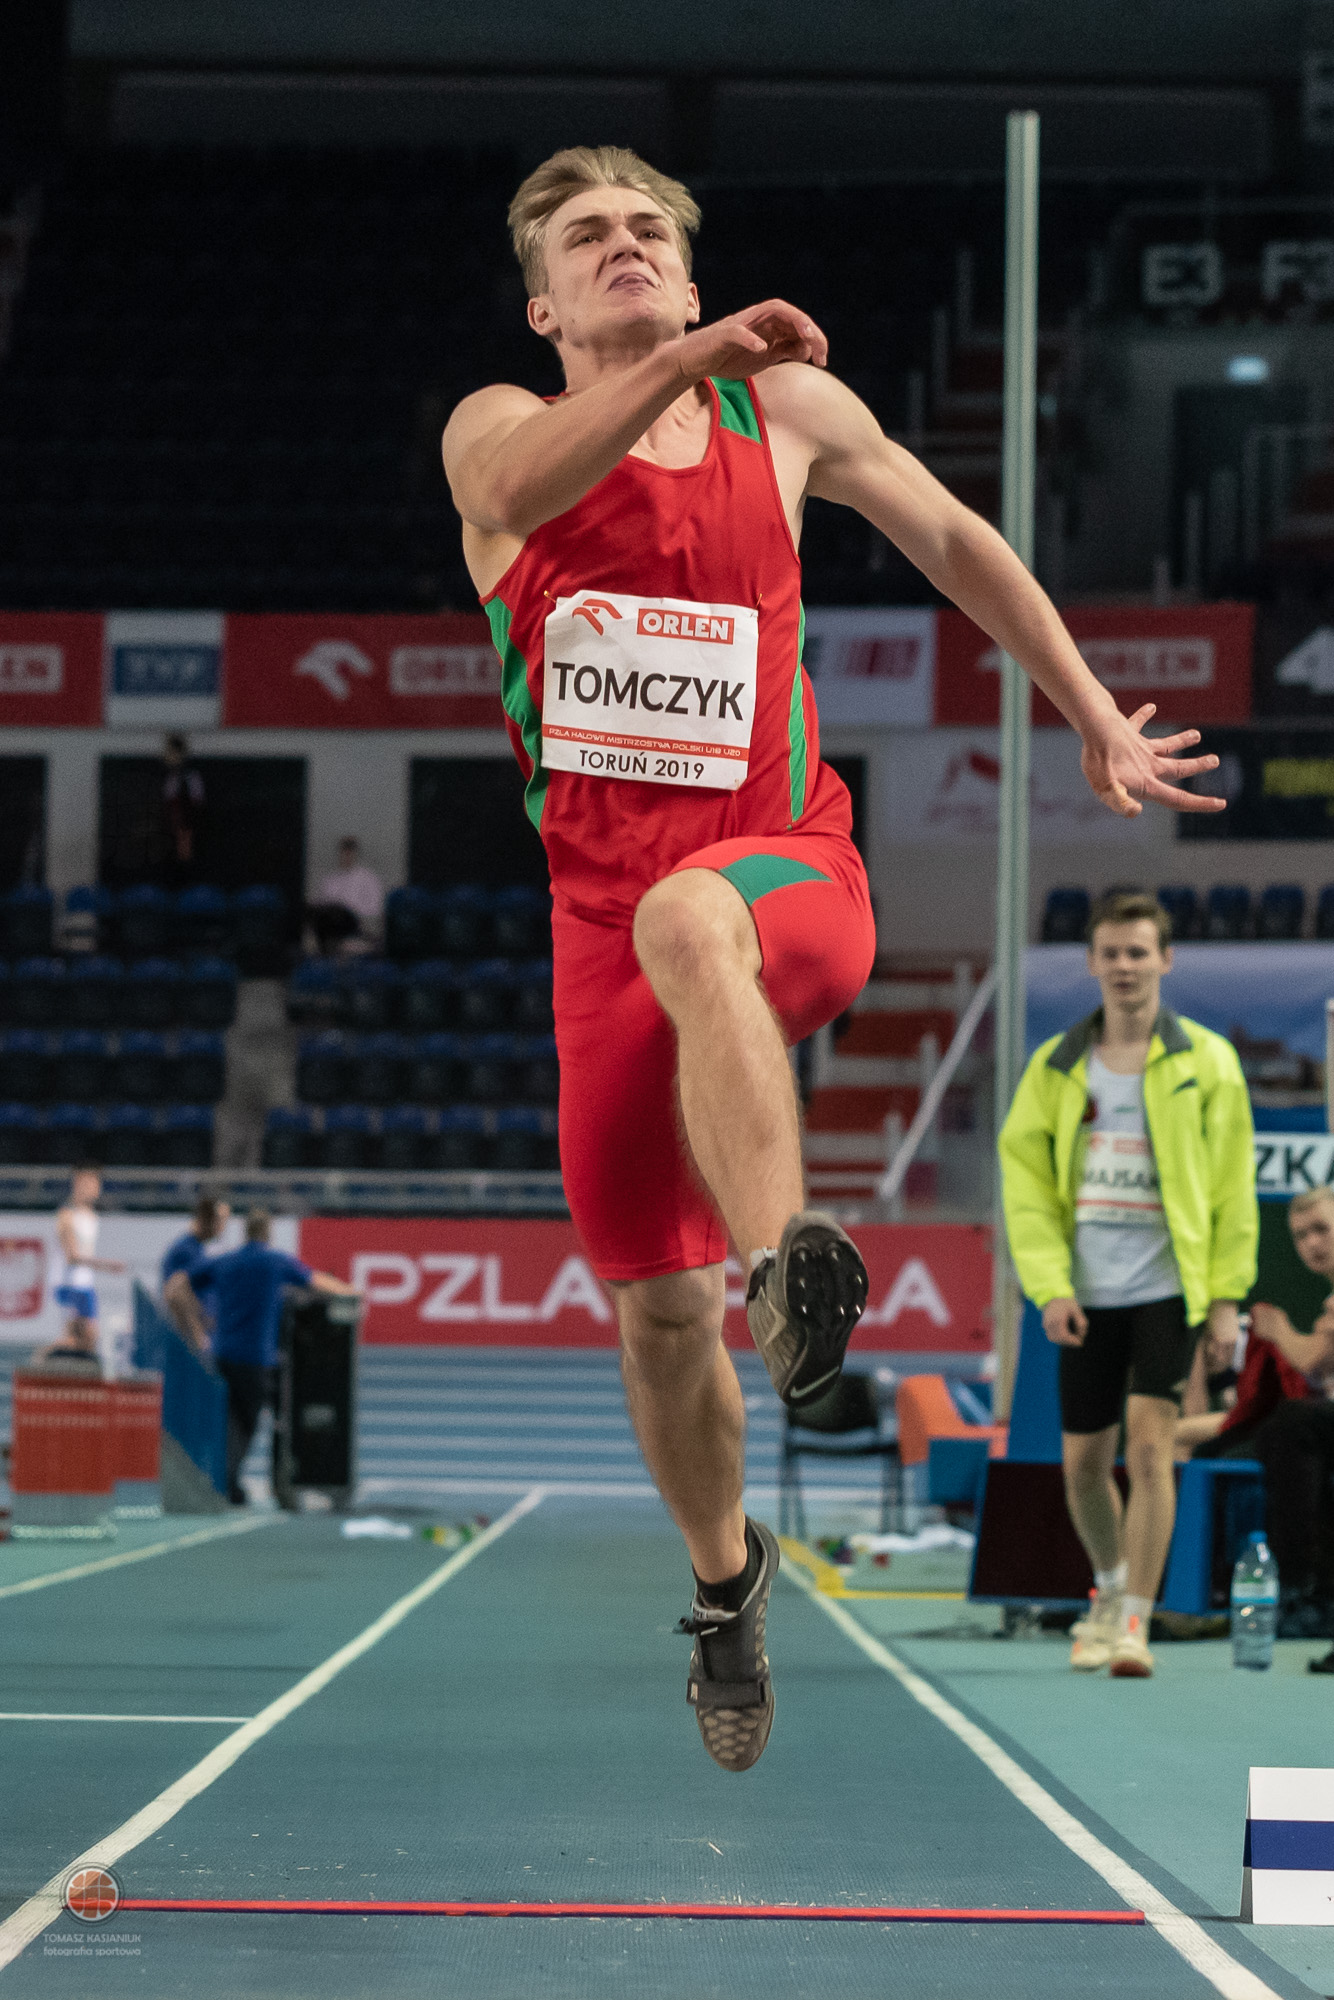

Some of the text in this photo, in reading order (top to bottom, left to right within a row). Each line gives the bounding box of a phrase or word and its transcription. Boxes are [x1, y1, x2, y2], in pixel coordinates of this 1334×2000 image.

[642, 611, 730, 641] ORLEN
[552, 661, 746, 721] TOMCZYK
[549, 727, 570, 738] PZLA
[571, 732, 605, 743] HALOWE
[606, 736, 671, 750] MISTRZOSTWA
[672, 743, 703, 754] POLSKI
[723, 748, 741, 757] U20
[579, 749, 705, 780] TORUŃ 2019
[351, 1250, 614, 1323] PZLA
